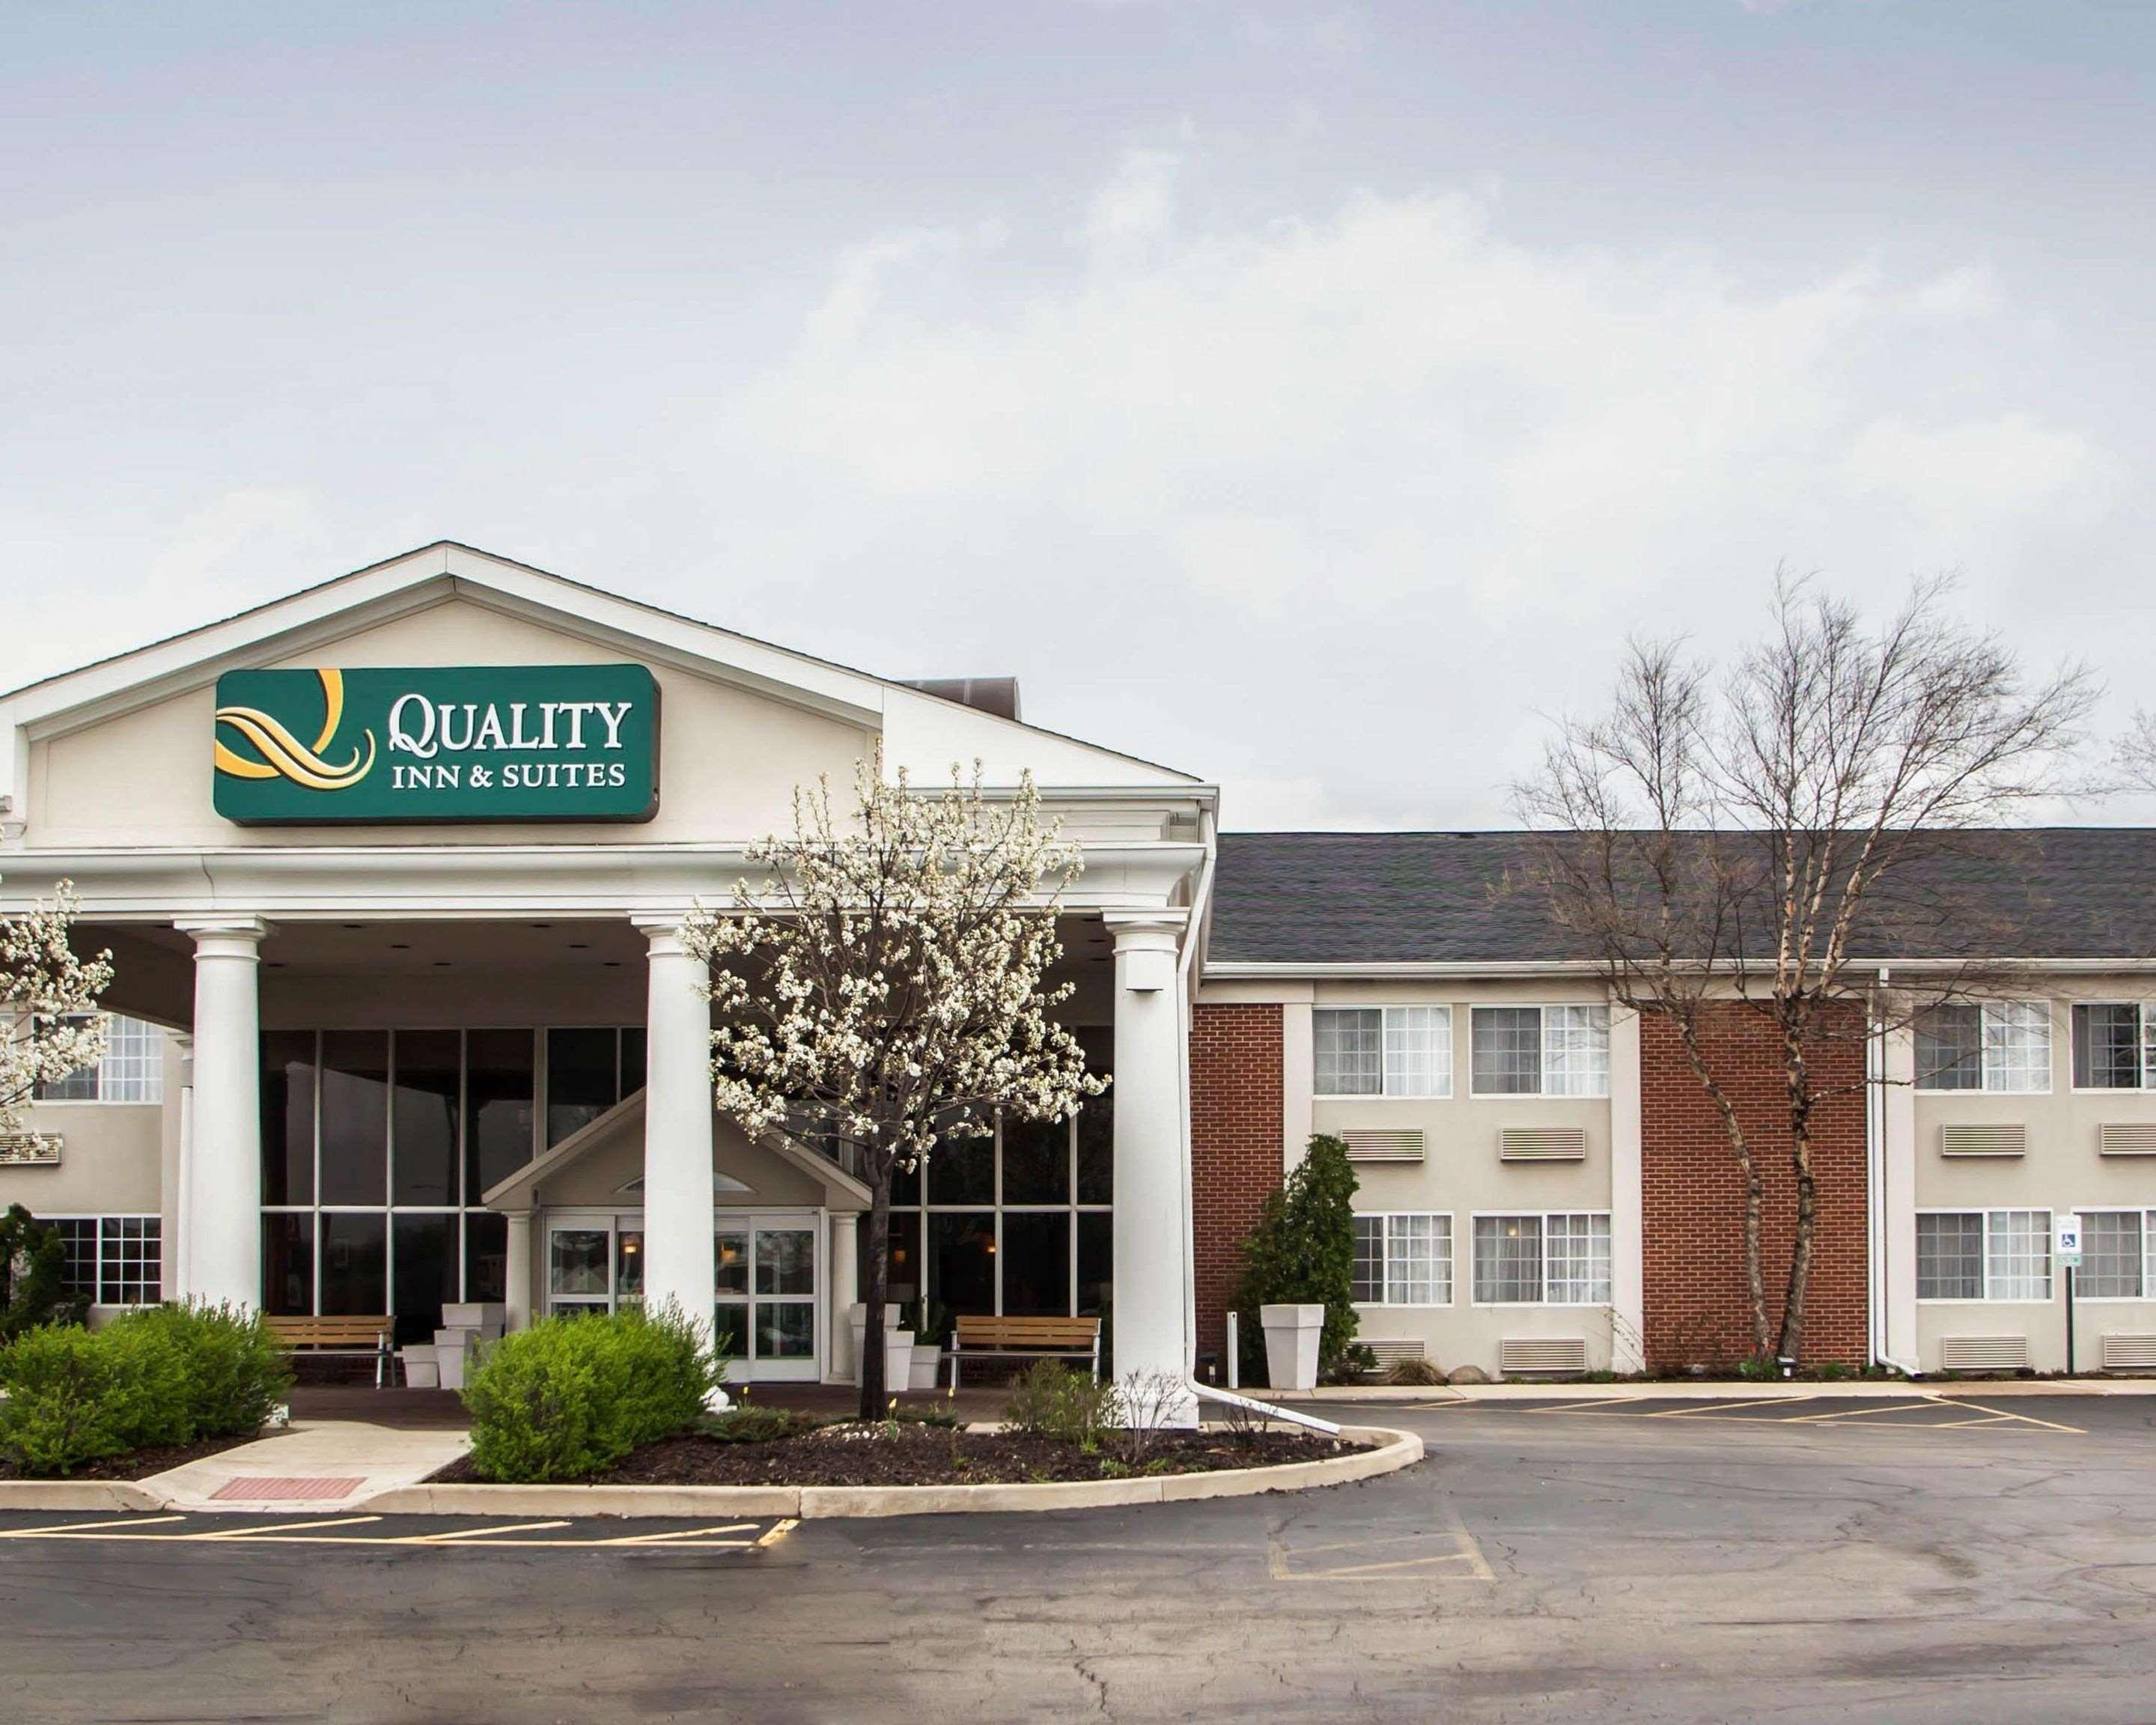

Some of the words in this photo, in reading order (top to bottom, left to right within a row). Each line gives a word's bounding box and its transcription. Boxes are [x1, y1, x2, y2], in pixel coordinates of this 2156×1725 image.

[389, 693, 632, 758] QUALITY
[392, 766, 460, 789] INN
[469, 765, 493, 788] &
[503, 763, 626, 788] SUITES
